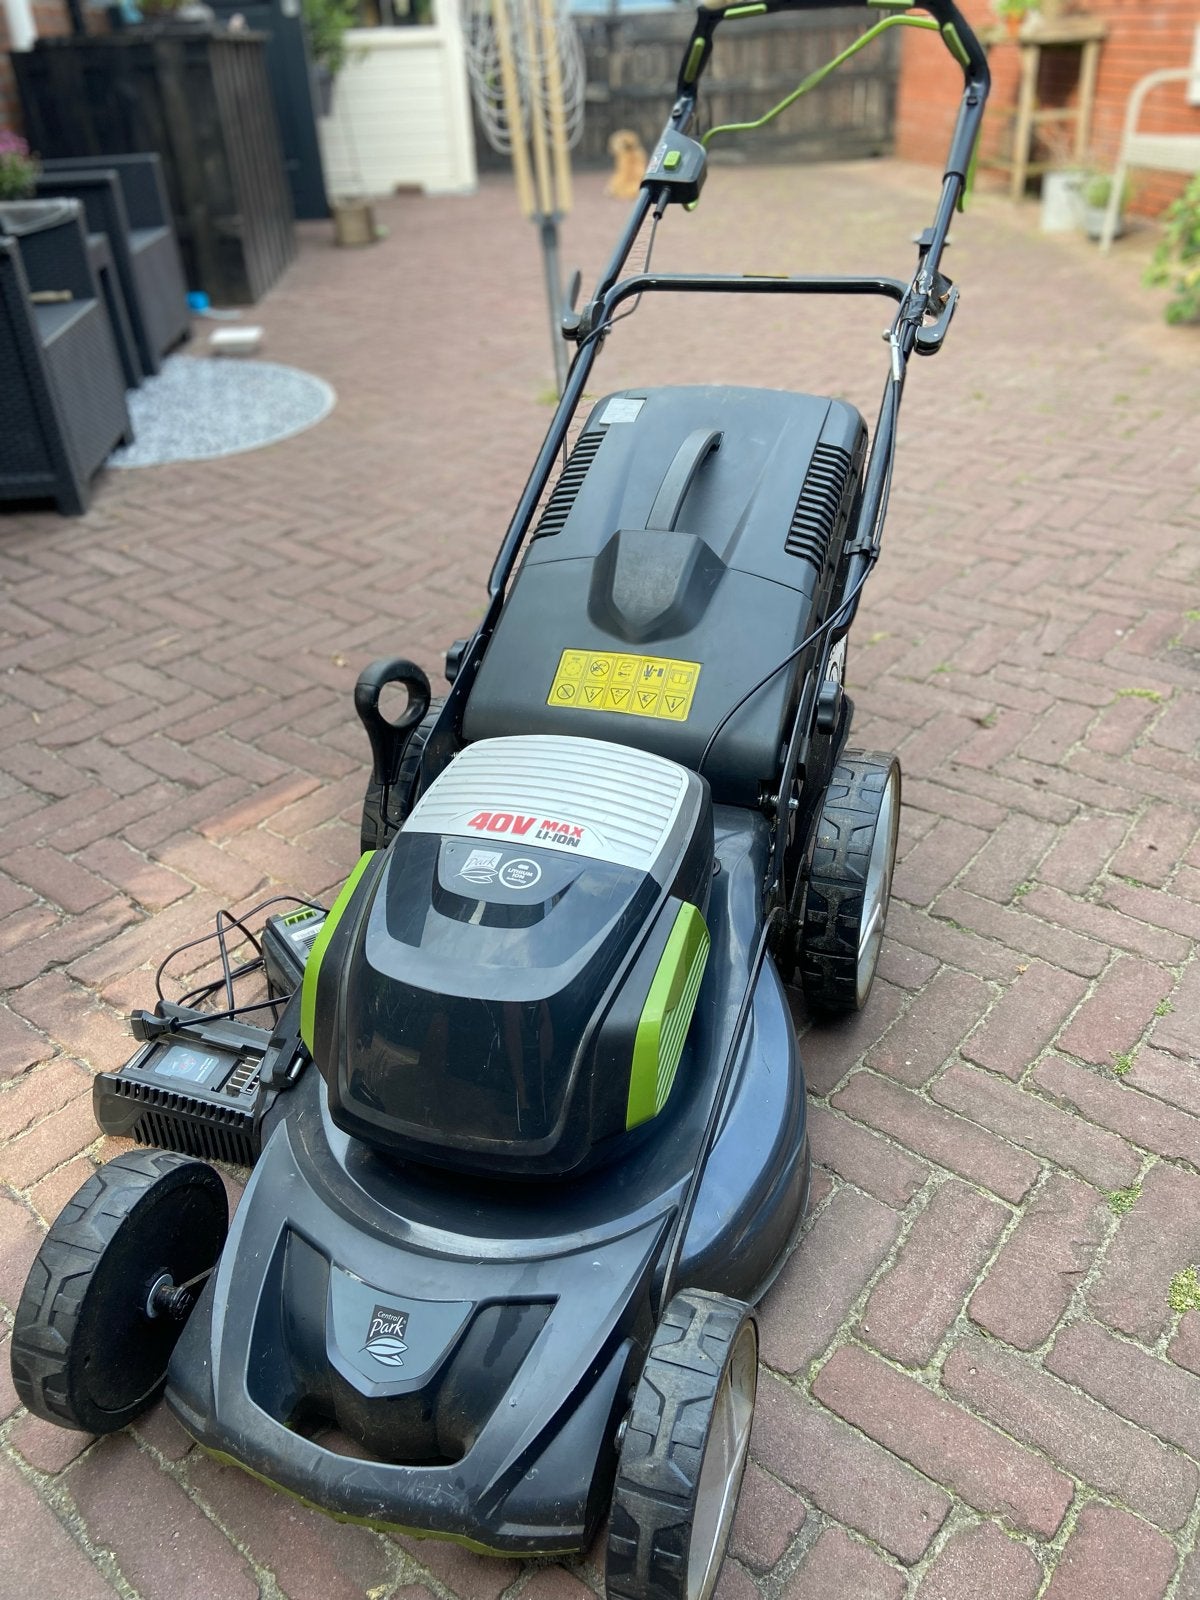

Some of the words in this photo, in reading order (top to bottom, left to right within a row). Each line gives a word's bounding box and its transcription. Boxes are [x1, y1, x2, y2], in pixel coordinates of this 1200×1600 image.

[467, 812, 537, 835] 40V
[540, 820, 585, 838] MAX
[535, 829, 581, 847] LI-ION
[507, 867, 533, 877] LITHIUM
[377, 1311, 400, 1321] Central
[370, 1317, 403, 1337] Park
